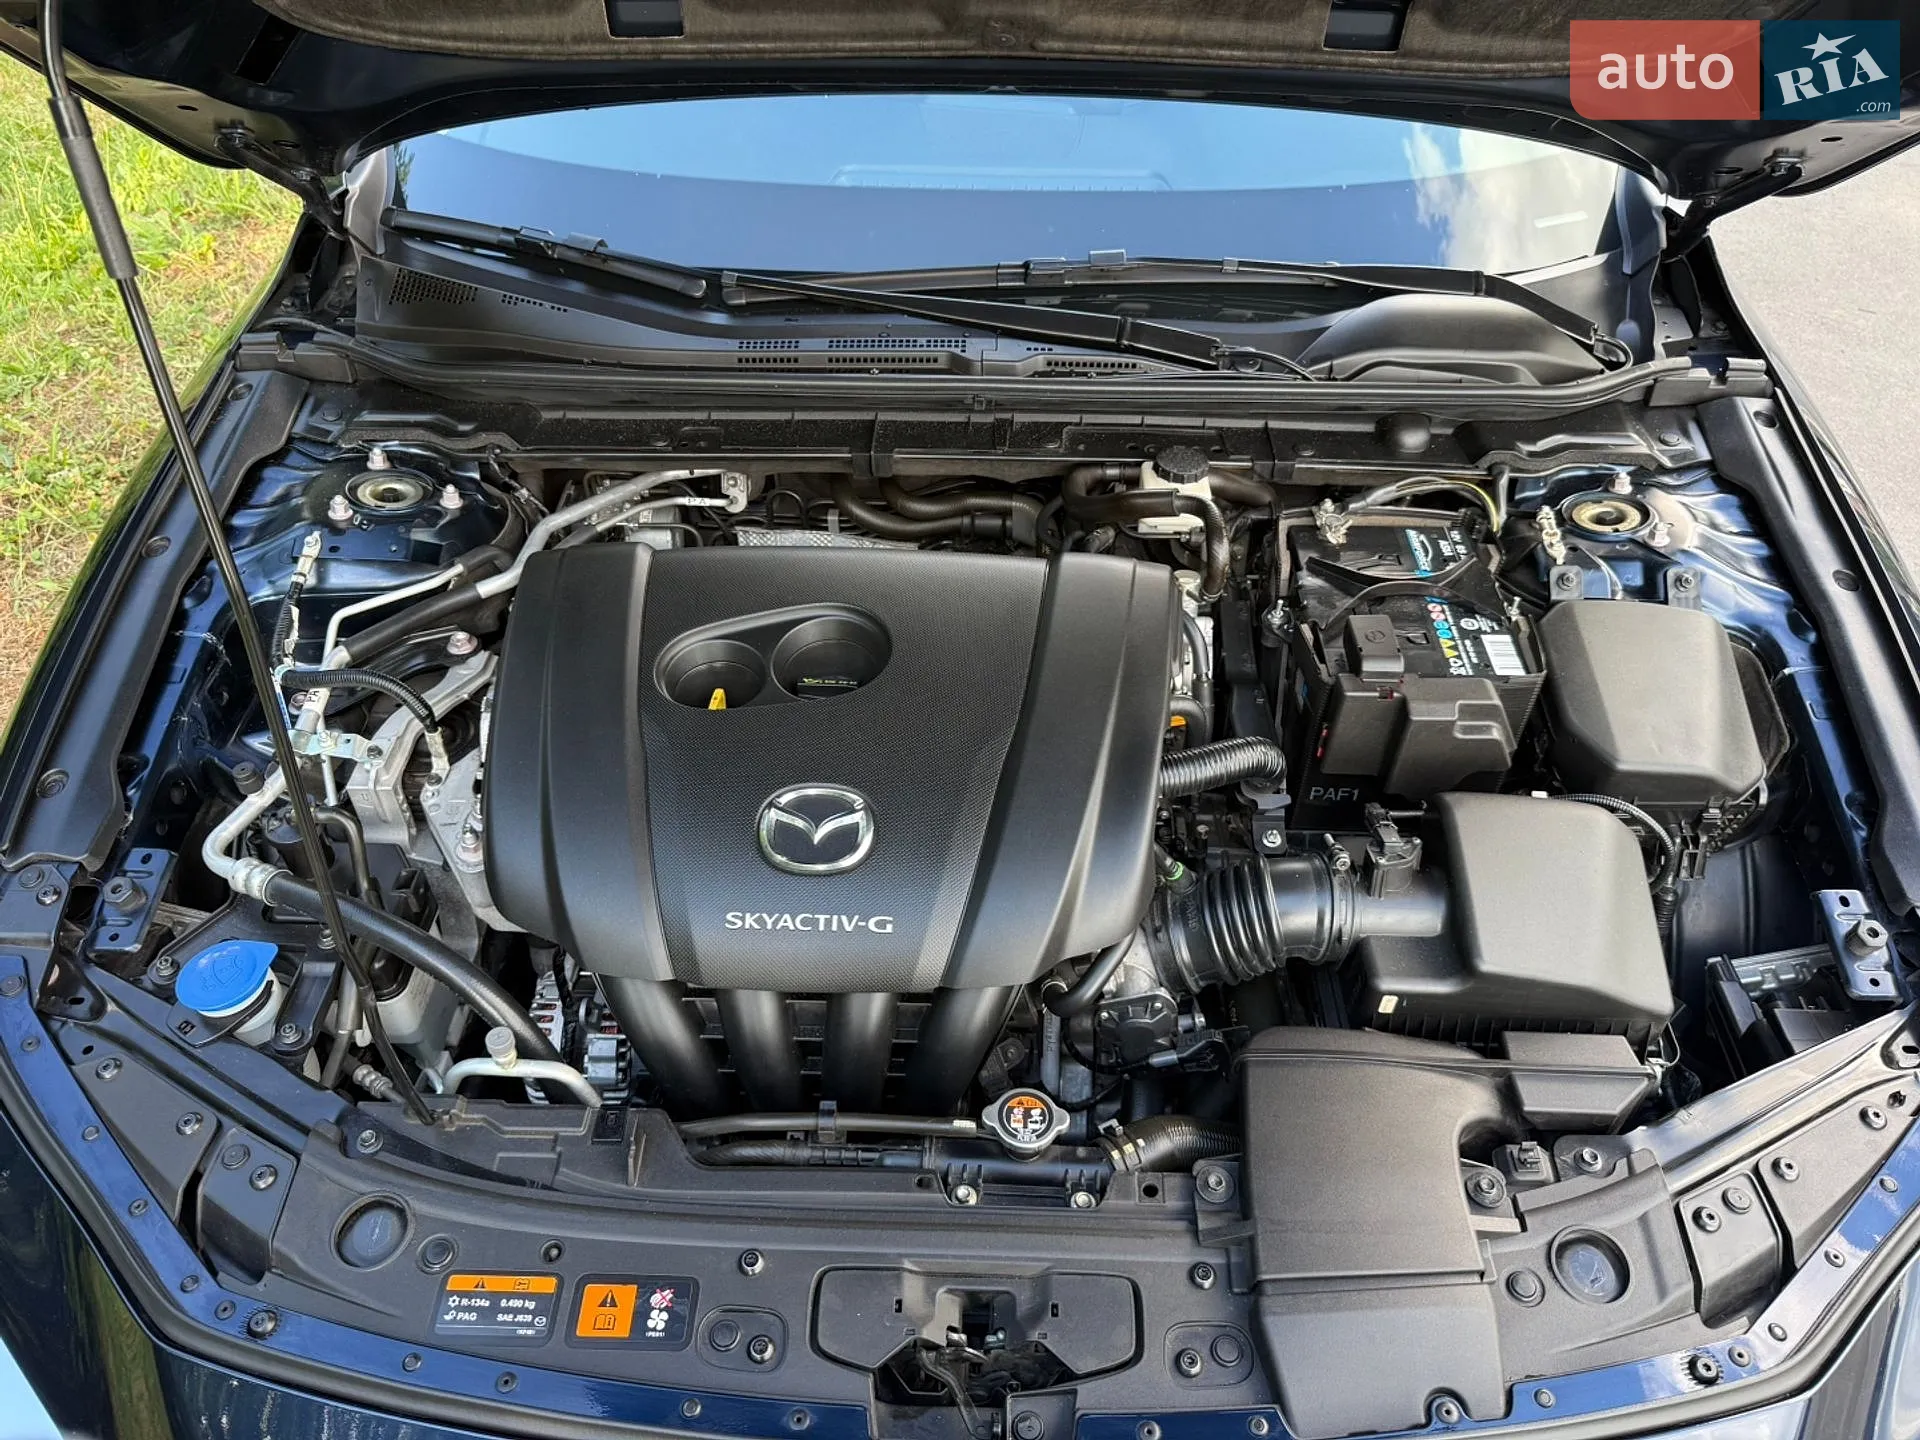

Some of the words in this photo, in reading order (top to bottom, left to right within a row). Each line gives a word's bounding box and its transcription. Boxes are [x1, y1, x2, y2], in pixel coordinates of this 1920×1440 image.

[1309, 786, 1360, 802] PAF1
[724, 911, 894, 934] SKYACTIV-G
[460, 1298, 491, 1307] R-134a
[524, 1299, 536, 1310] kg
[456, 1312, 477, 1321] PAG
[496, 1313, 513, 1322] SAE
